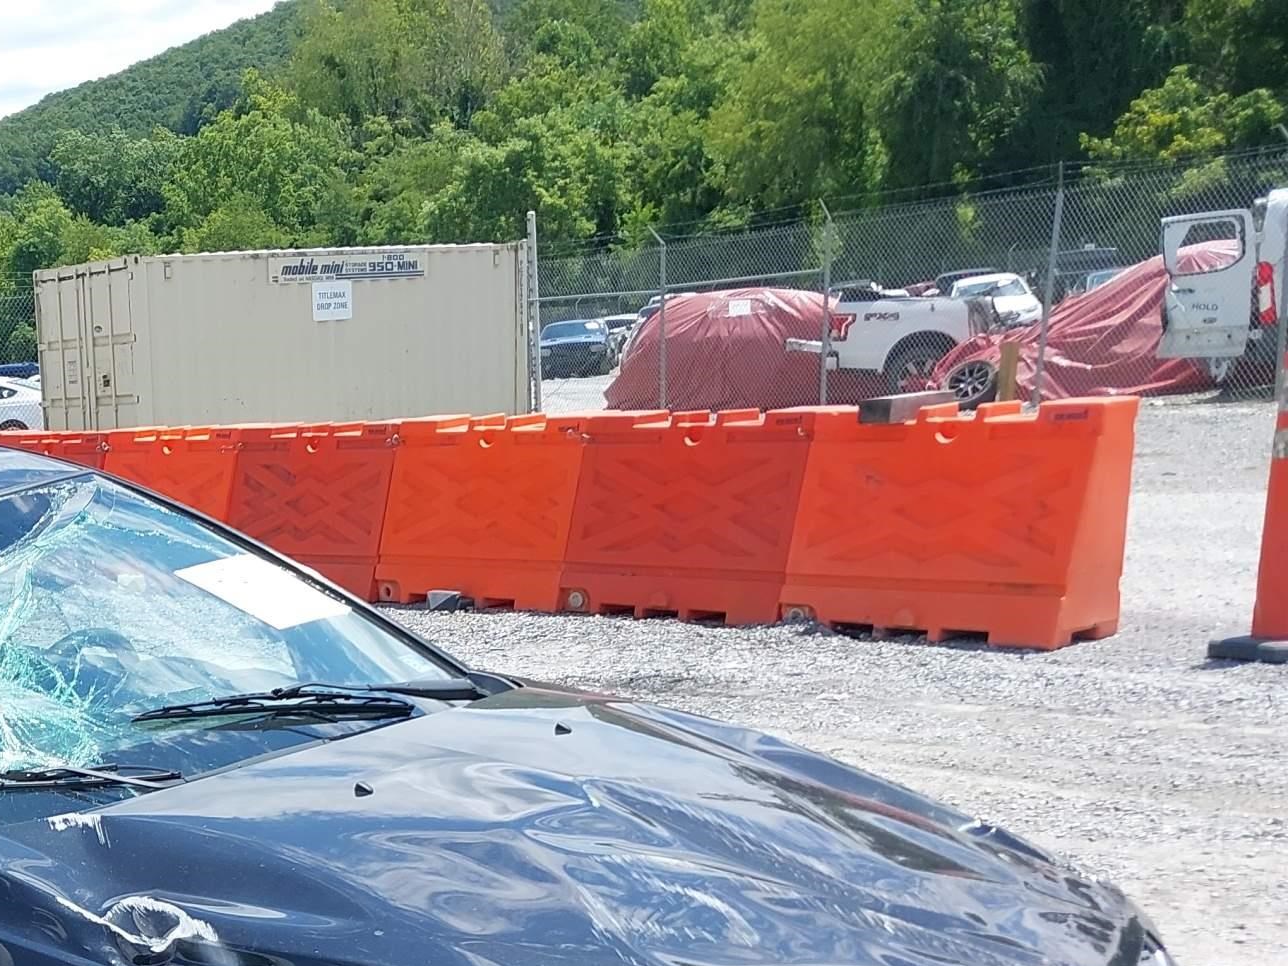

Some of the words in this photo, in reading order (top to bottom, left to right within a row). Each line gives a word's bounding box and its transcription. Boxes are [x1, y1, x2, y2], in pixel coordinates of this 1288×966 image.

[281, 258, 318, 276] mobile
[320, 260, 344, 274] mini
[318, 291, 346, 299] TITLEMAX
[317, 302, 332, 310] DROP
[333, 302, 348, 310] ZONE
[1192, 303, 1218, 311] HOLD
